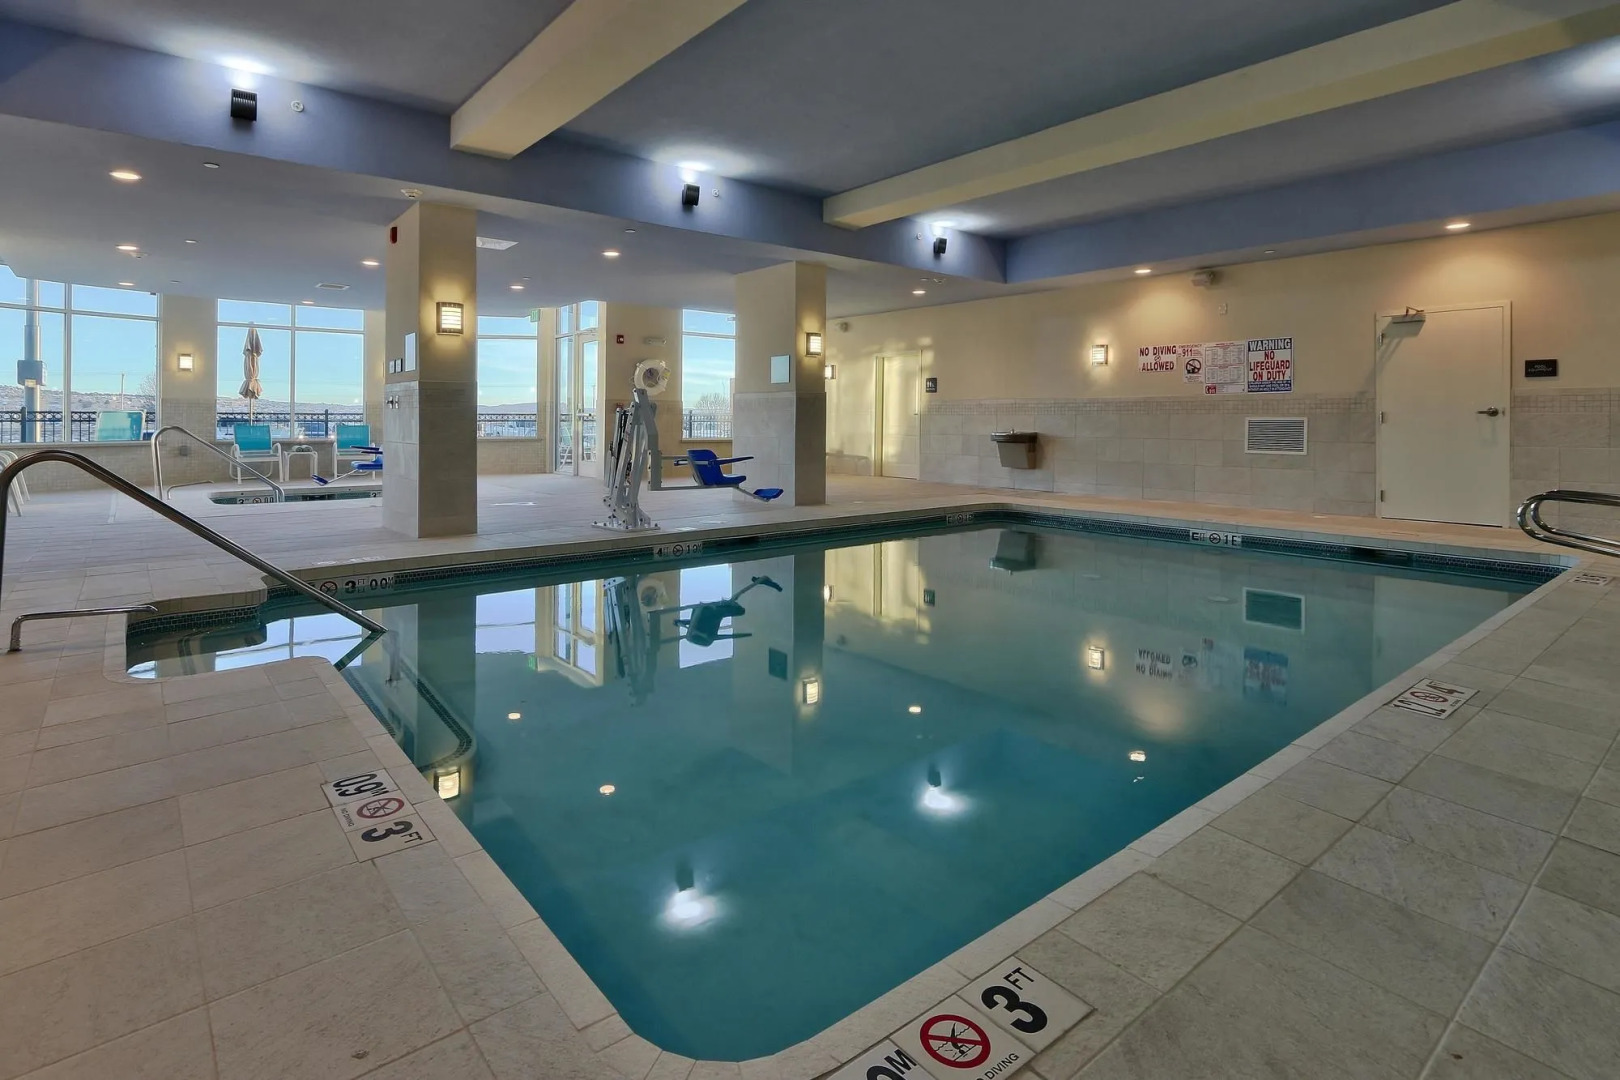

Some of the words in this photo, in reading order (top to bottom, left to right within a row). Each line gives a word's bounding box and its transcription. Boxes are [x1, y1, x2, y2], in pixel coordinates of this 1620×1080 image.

[1249, 338, 1291, 351] WARNING
[1140, 347, 1150, 357] NO
[1153, 345, 1177, 356] DIVING
[1182, 348, 1193, 357] 911
[1264, 351, 1275, 360] NO
[1142, 361, 1175, 371] ALLOWED
[1249, 360, 1291, 371] LIFEGUARD
[1253, 371, 1263, 381] ON
[1266, 370, 1287, 381] DUTY
[361, 820, 413, 842] 3
[400, 831, 423, 844] FT
[1003, 967, 1035, 991] FT
[980, 985, 1048, 1034] 3
[984, 1052, 1020, 1080] DIVING
